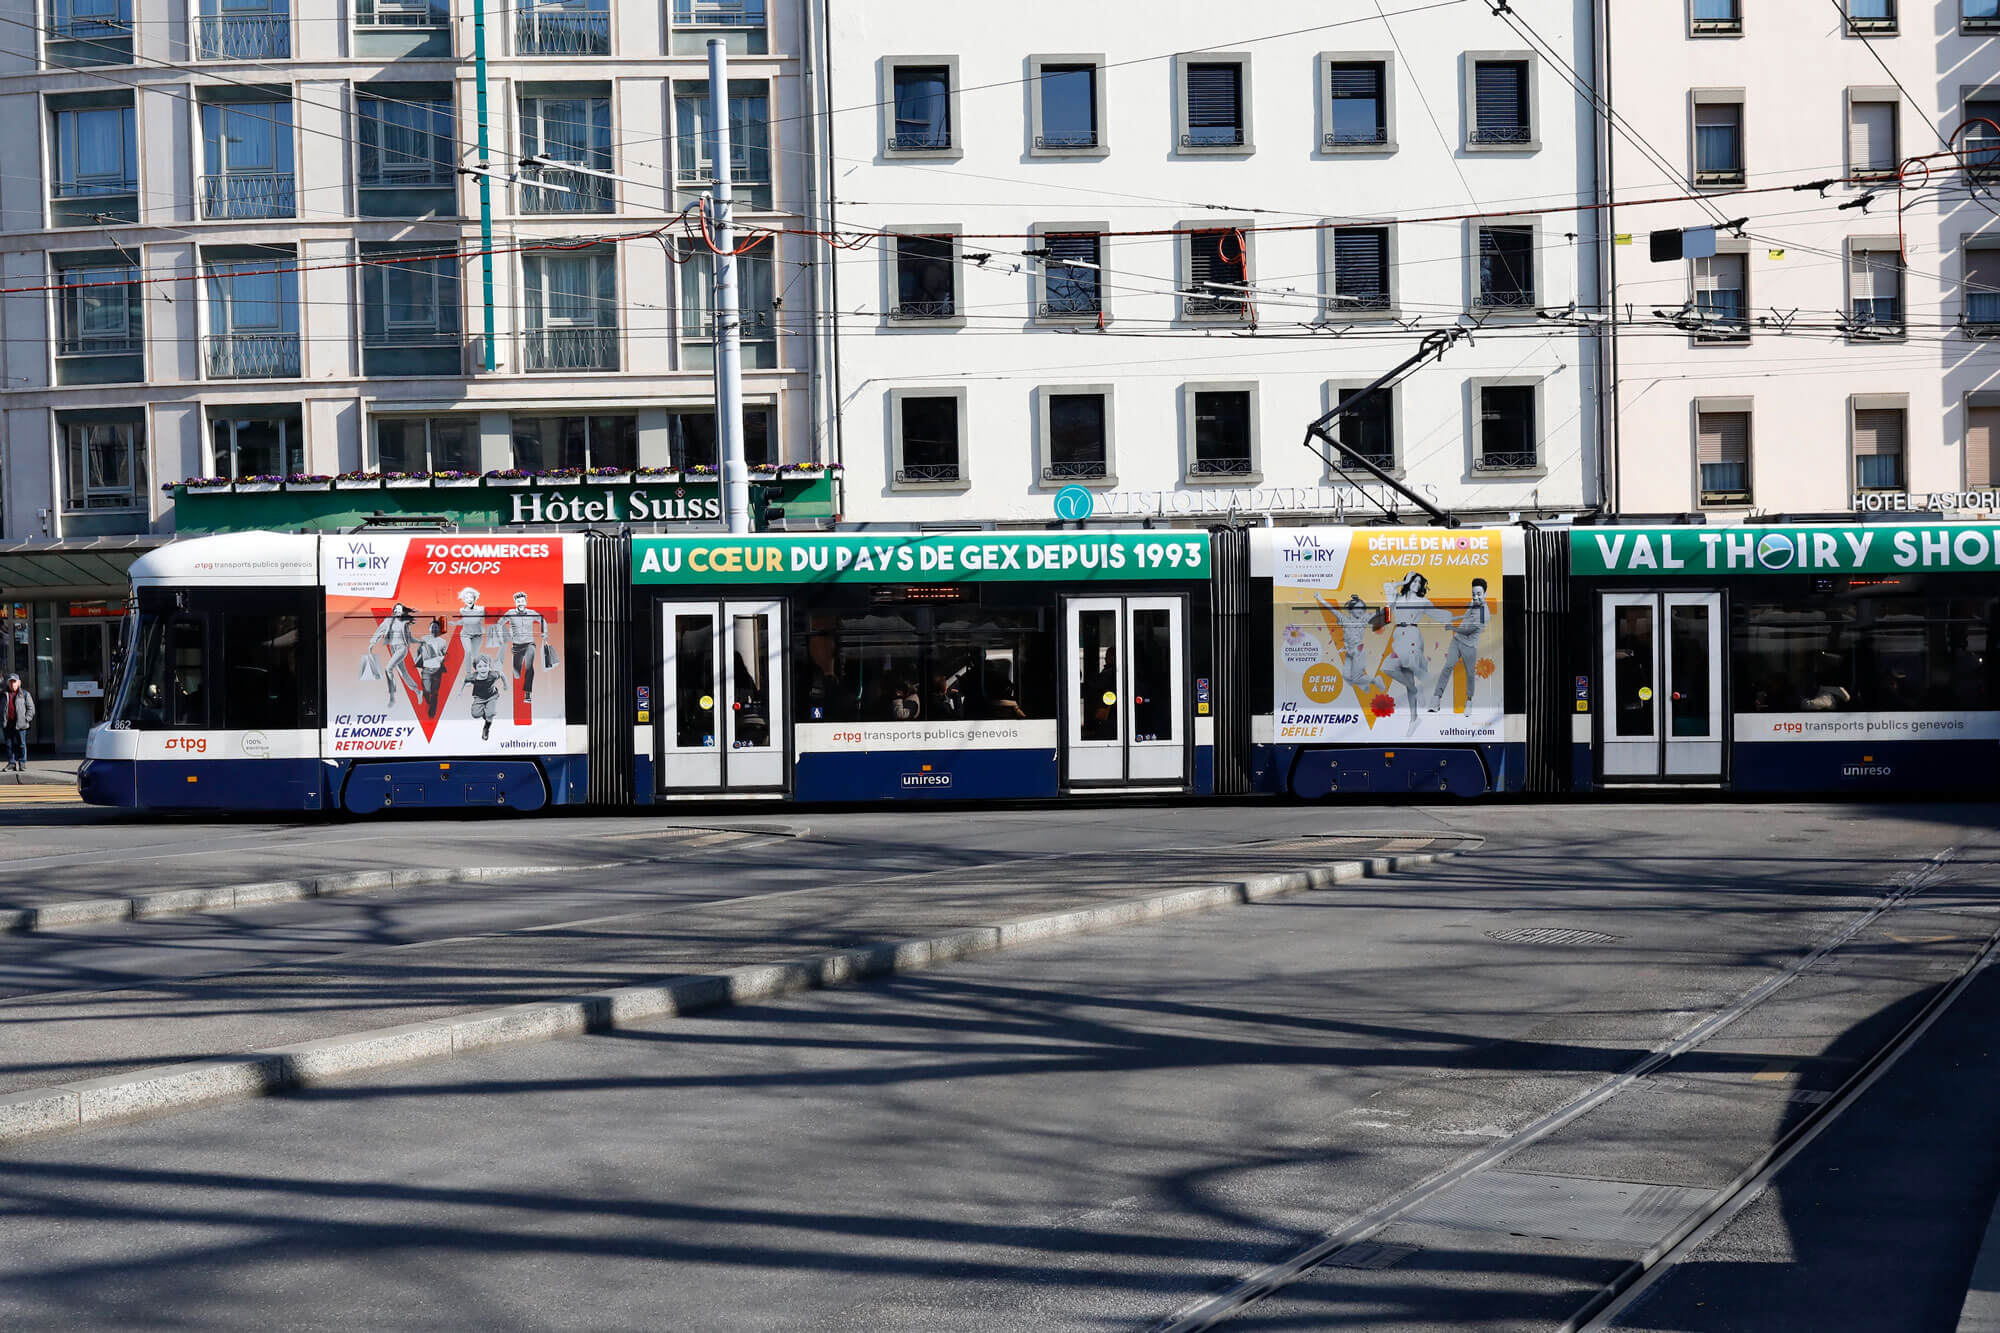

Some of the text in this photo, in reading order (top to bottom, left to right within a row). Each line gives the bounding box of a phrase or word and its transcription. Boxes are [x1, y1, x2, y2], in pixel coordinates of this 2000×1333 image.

[510, 488, 721, 523] Hôtel Suiss
[1852, 493, 1919, 511] HOTEL
[1293, 535, 1320, 547] VAL
[1368, 533, 1488, 550] DÉFILÉ DE MODE
[348, 542, 375, 554] VAL
[425, 543, 550, 558] 70 COMMERCES
[1282, 548, 1335, 561] THOIRY
[1594, 534, 1685, 569] VAL
[1699, 531, 1874, 570] THOIRY
[640, 547, 682, 572] AU
[791, 546, 828, 572] DU
[835, 545, 914, 571] PAYS
[920, 545, 954, 571] DE
[959, 545, 1021, 570] GEX
[1026, 543, 1126, 569] DEPUIS
[1133, 543, 1201, 568] 1993
[1369, 552, 1489, 567] SAMEDI 15 MARS
[214, 560, 252, 569] transports
[252, 560, 279, 569] publics
[280, 560, 313, 569] genevois
[427, 560, 502, 575] 70 SHOPS
[1309, 675, 1337, 683] DE 15H
[1320, 684, 1335, 692] 17H
[1281, 702, 1298, 712] ICI,
[114, 719, 132, 730] 862
[335, 714, 388, 726] ICI, TOUT
[1281, 714, 1359, 724] LE PRINTEMPS
[335, 726, 415, 738] LE MONDE S'Y
[1783, 719, 1964, 733] tpg transports publics genevois
[843, 728, 1018, 742] tpg transports publics genevois
[1440, 728, 1495, 738] valthoiry.com
[180, 736, 207, 753] tpg
[335, 740, 397, 751] RETROUVE
[500, 739, 558, 750] valthoiry.com
[1843, 763, 1891, 776] unireso
[903, 772, 950, 785] unireso
